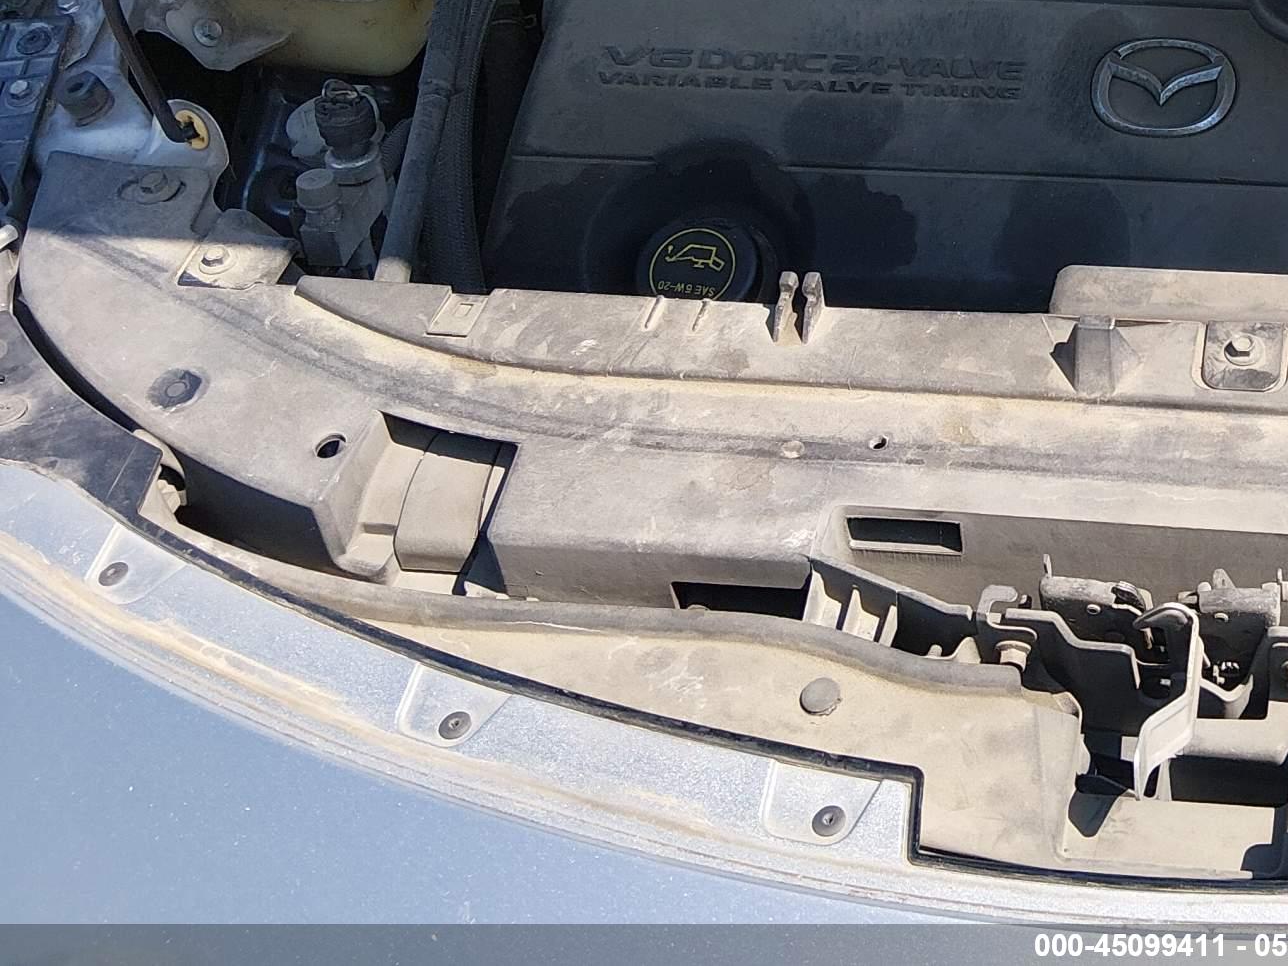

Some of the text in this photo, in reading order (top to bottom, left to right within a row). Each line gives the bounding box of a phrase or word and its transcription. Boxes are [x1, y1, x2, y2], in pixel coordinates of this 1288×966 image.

[603, 43, 692, 69] V6
[697, 48, 828, 75] DOHC
[598, 71, 1023, 100] VARIABLE VALVE TIMING
[695, 285, 716, 297] SAE
